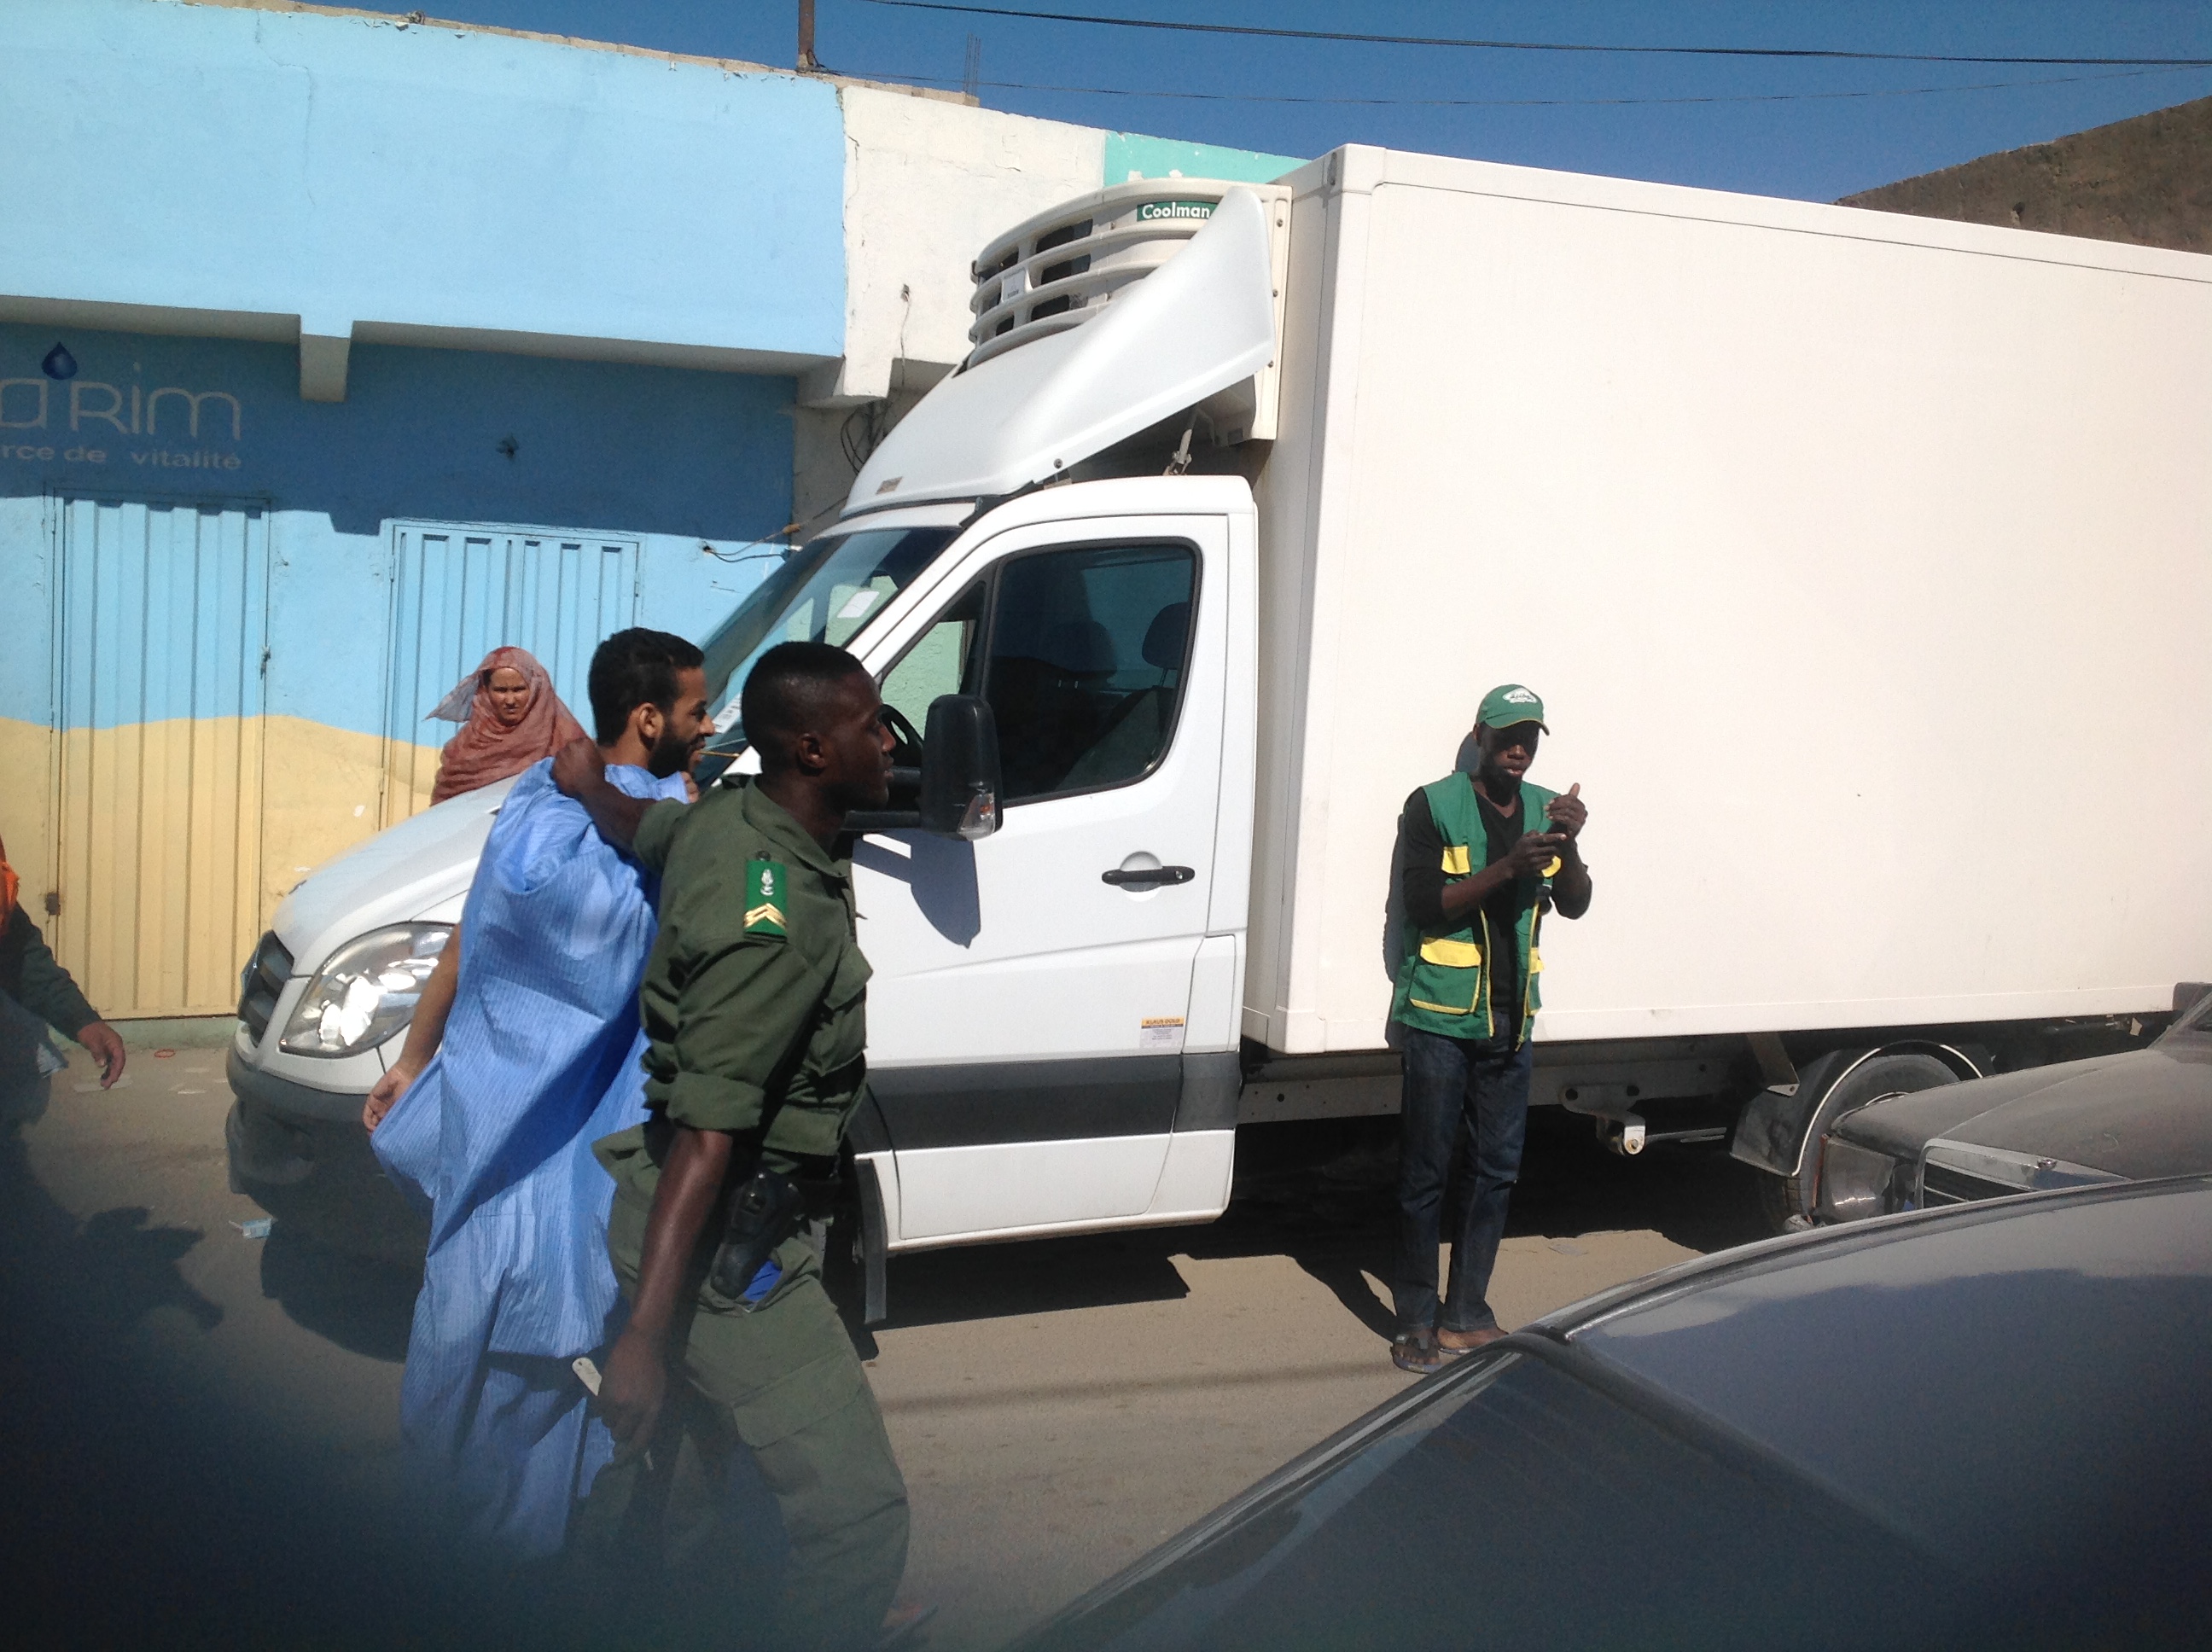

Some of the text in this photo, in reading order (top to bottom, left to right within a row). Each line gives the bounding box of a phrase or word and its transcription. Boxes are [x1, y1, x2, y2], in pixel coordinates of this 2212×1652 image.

[1142, 201, 1211, 219] Coolman
[64, 445, 107, 463] de
[131, 448, 242, 470] vitalité
